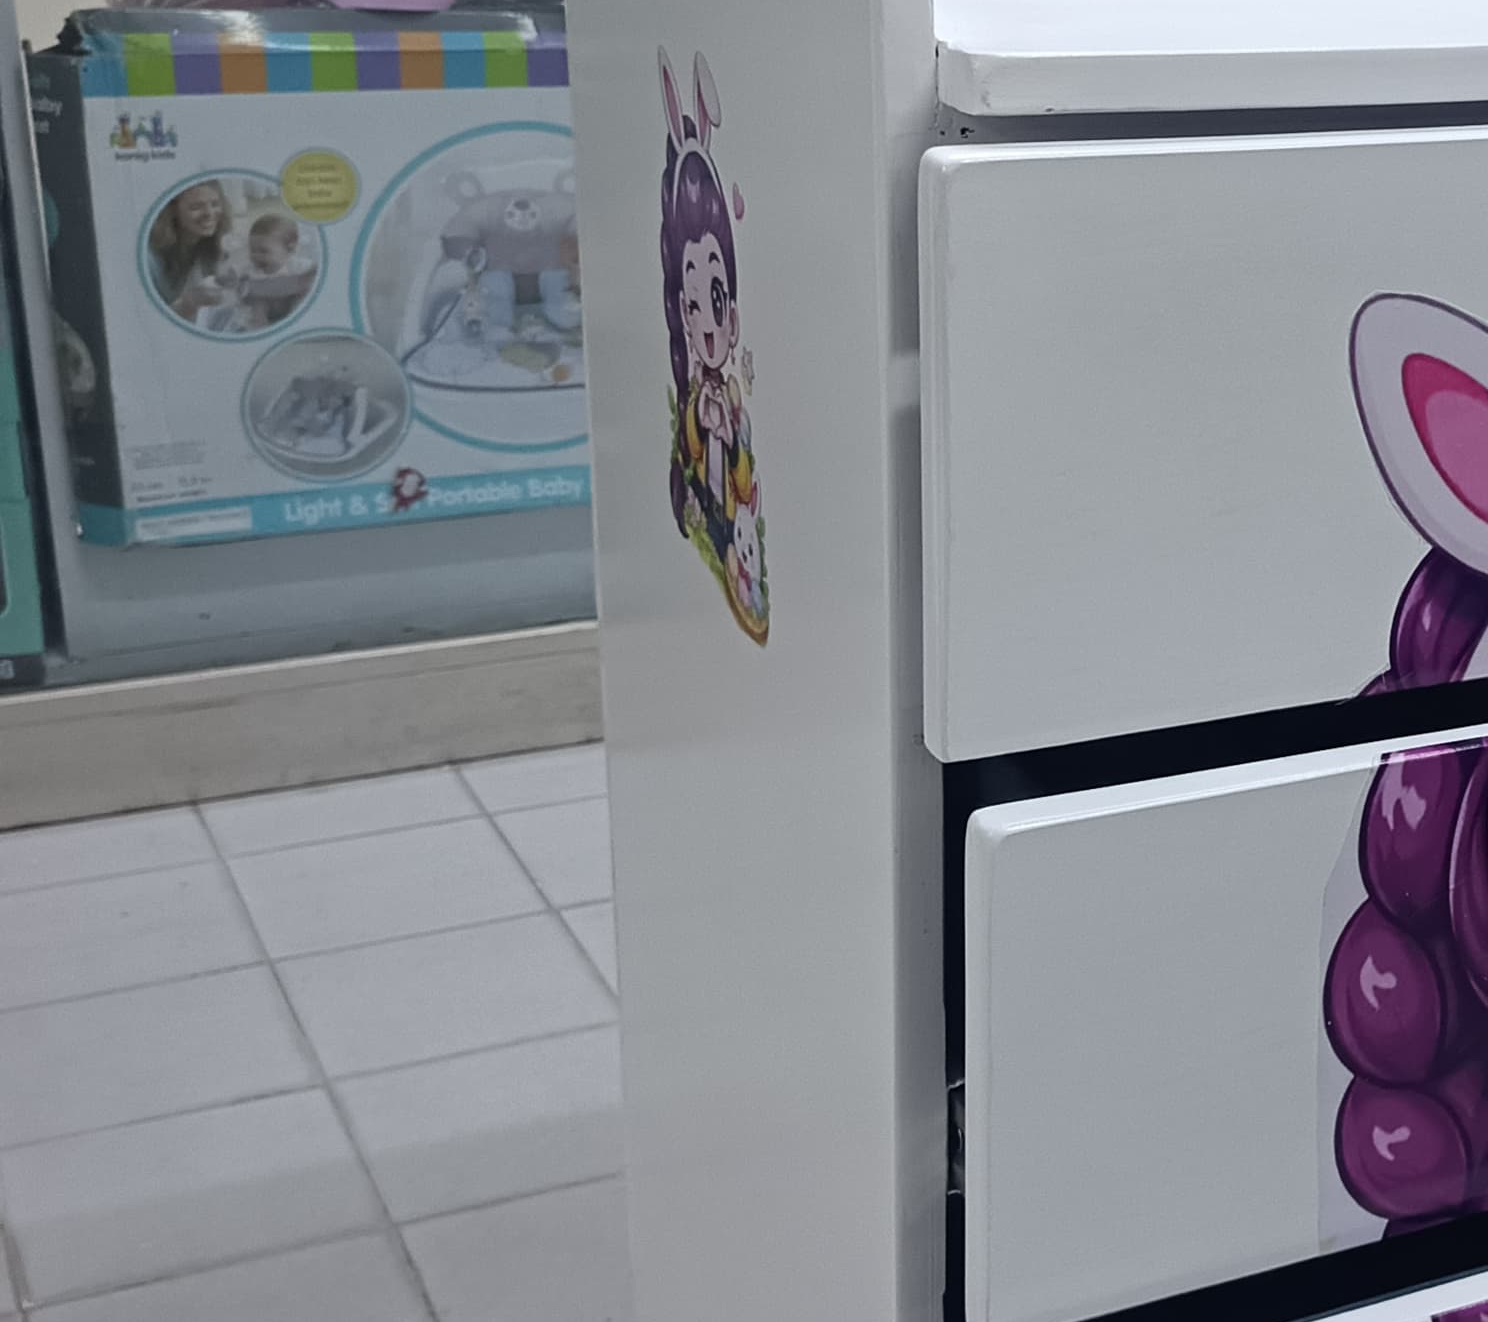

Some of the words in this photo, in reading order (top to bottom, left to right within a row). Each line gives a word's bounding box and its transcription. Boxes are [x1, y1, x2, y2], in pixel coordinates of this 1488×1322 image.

[284, 499, 342, 526] Light
[428, 483, 522, 508] Portable
[529, 477, 581, 500] Baby
